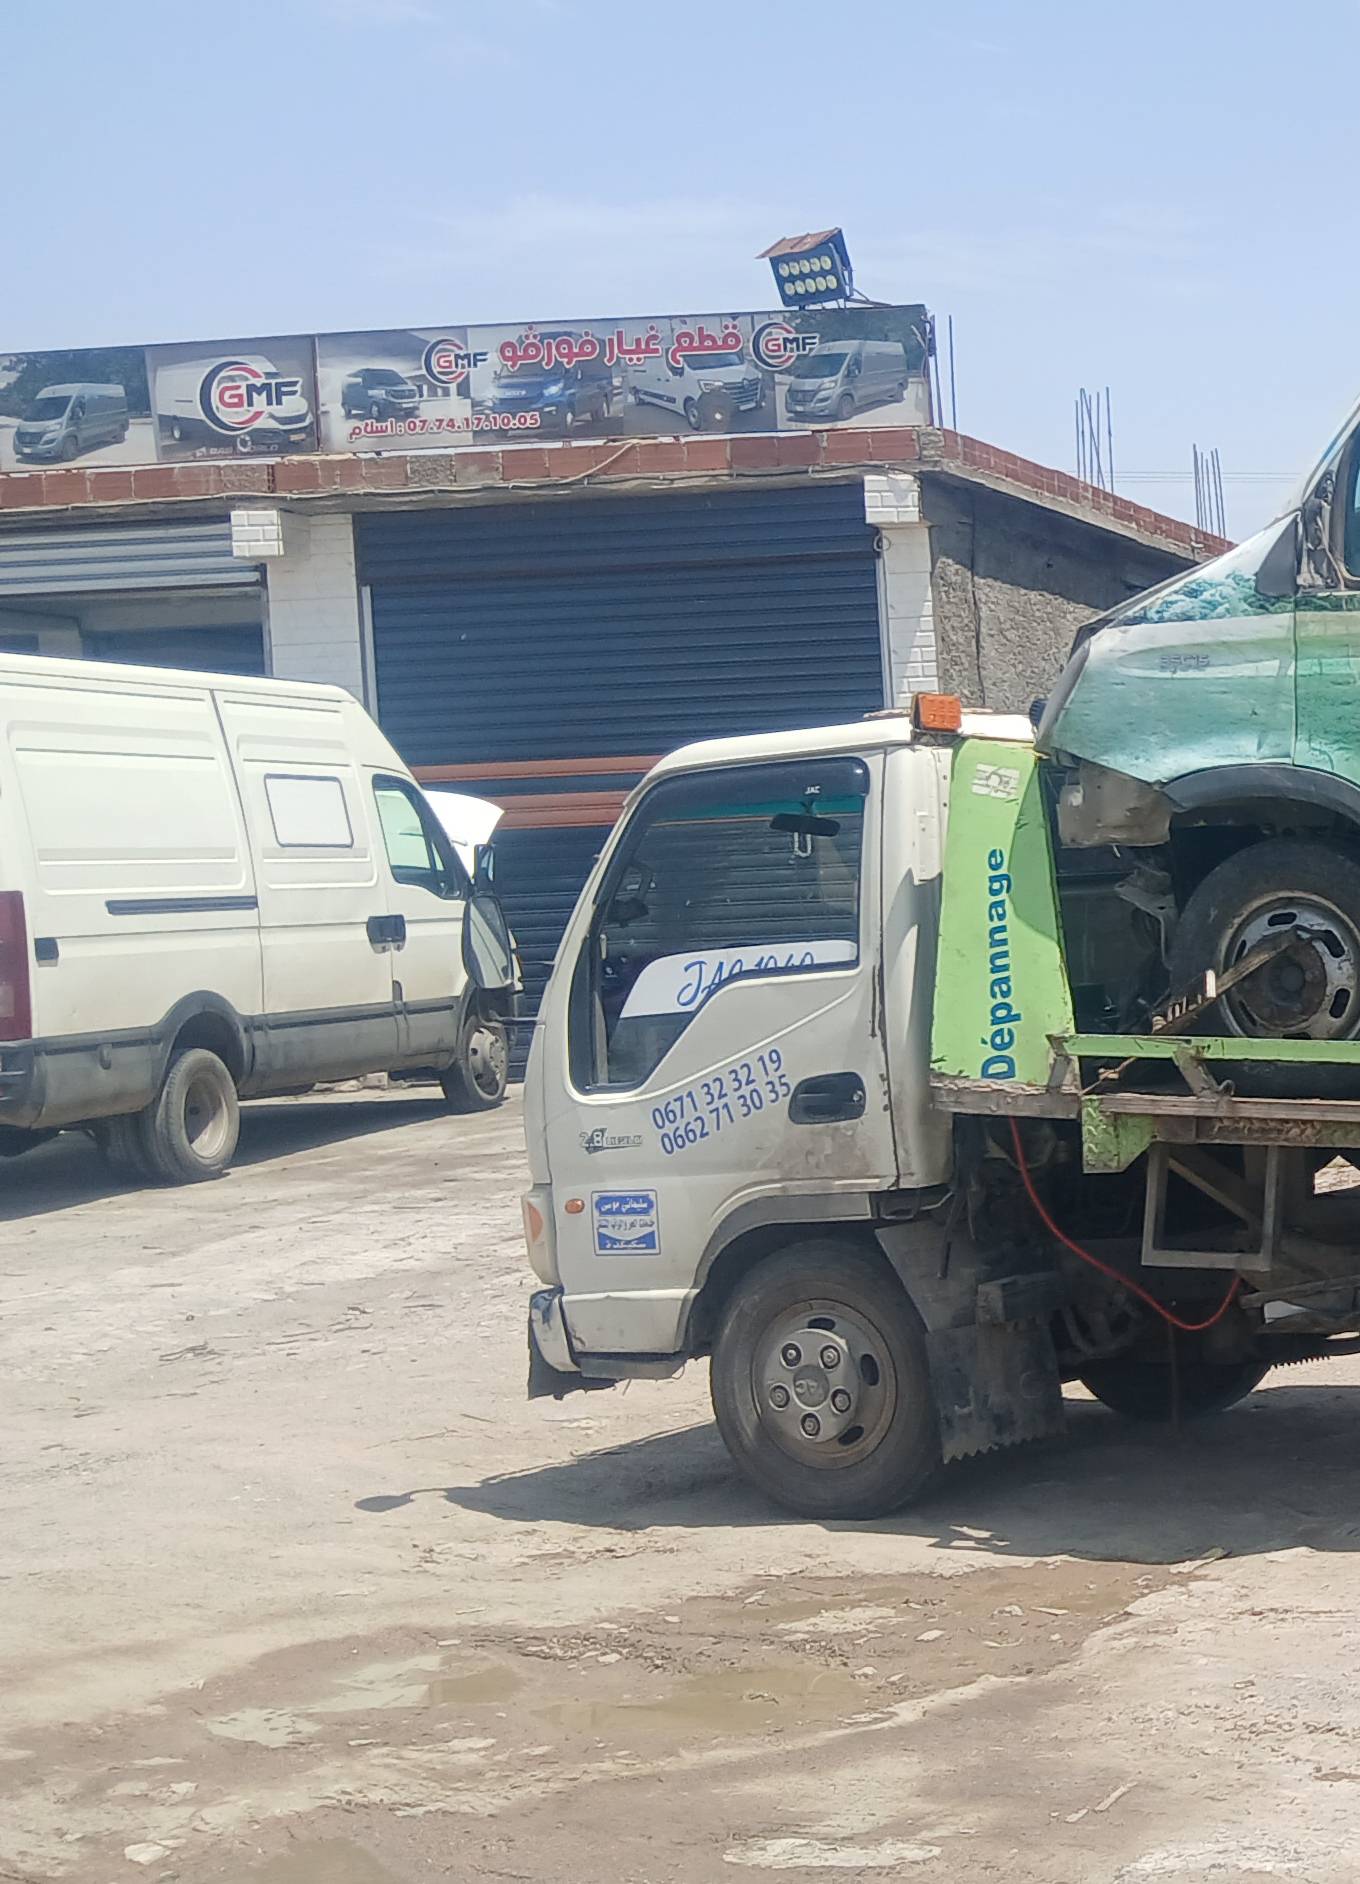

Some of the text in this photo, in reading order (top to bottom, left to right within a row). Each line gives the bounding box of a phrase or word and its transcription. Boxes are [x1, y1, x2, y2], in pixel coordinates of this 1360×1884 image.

[436, 351, 489, 369] GMF
[604, 324, 663, 366] غيار
[669, 323, 743, 367] قطع
[764, 335, 818, 353] GMF
[217, 378, 303, 408] GMF
[406, 412, 540, 434] 07.74.17.10.05
[980, 846, 1022, 1081] Dépannage
[652, 1049, 782, 1130] 0671 32 32 19
[660, 1115, 710, 1155] 0662
[709, 1102, 735, 1131] 71
[737, 1088, 764, 1118] 30
[765, 1074, 791, 1103] 35
